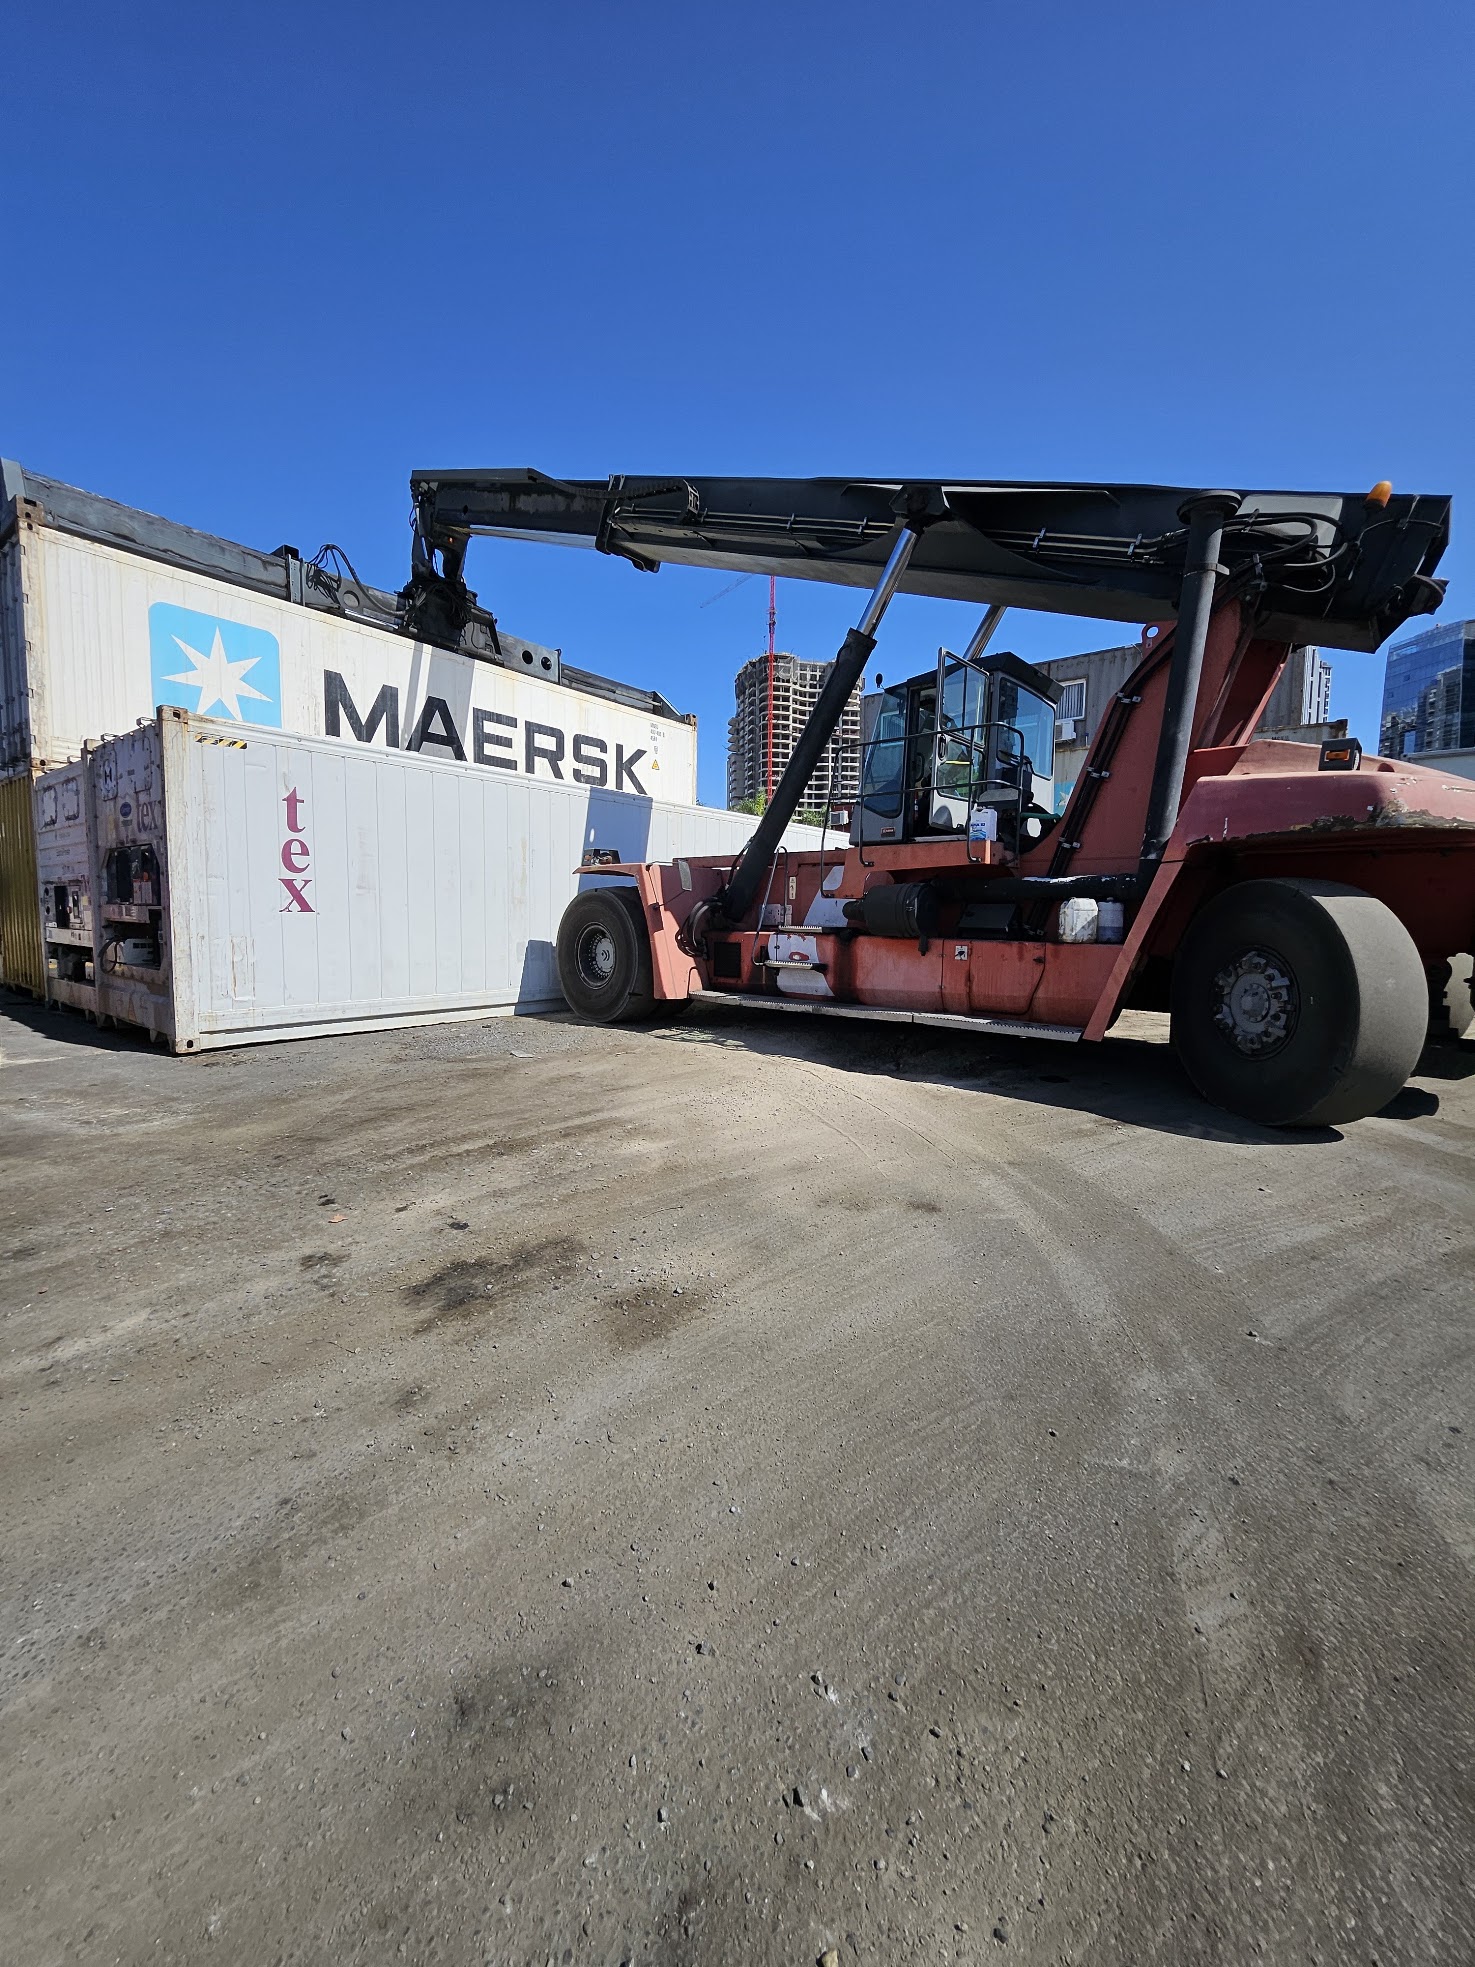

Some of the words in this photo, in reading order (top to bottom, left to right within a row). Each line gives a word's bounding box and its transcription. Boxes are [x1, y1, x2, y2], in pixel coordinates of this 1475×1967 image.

[323, 668, 648, 796] MAERSK
[135, 797, 159, 834] tex
[278, 786, 316, 913] tex
